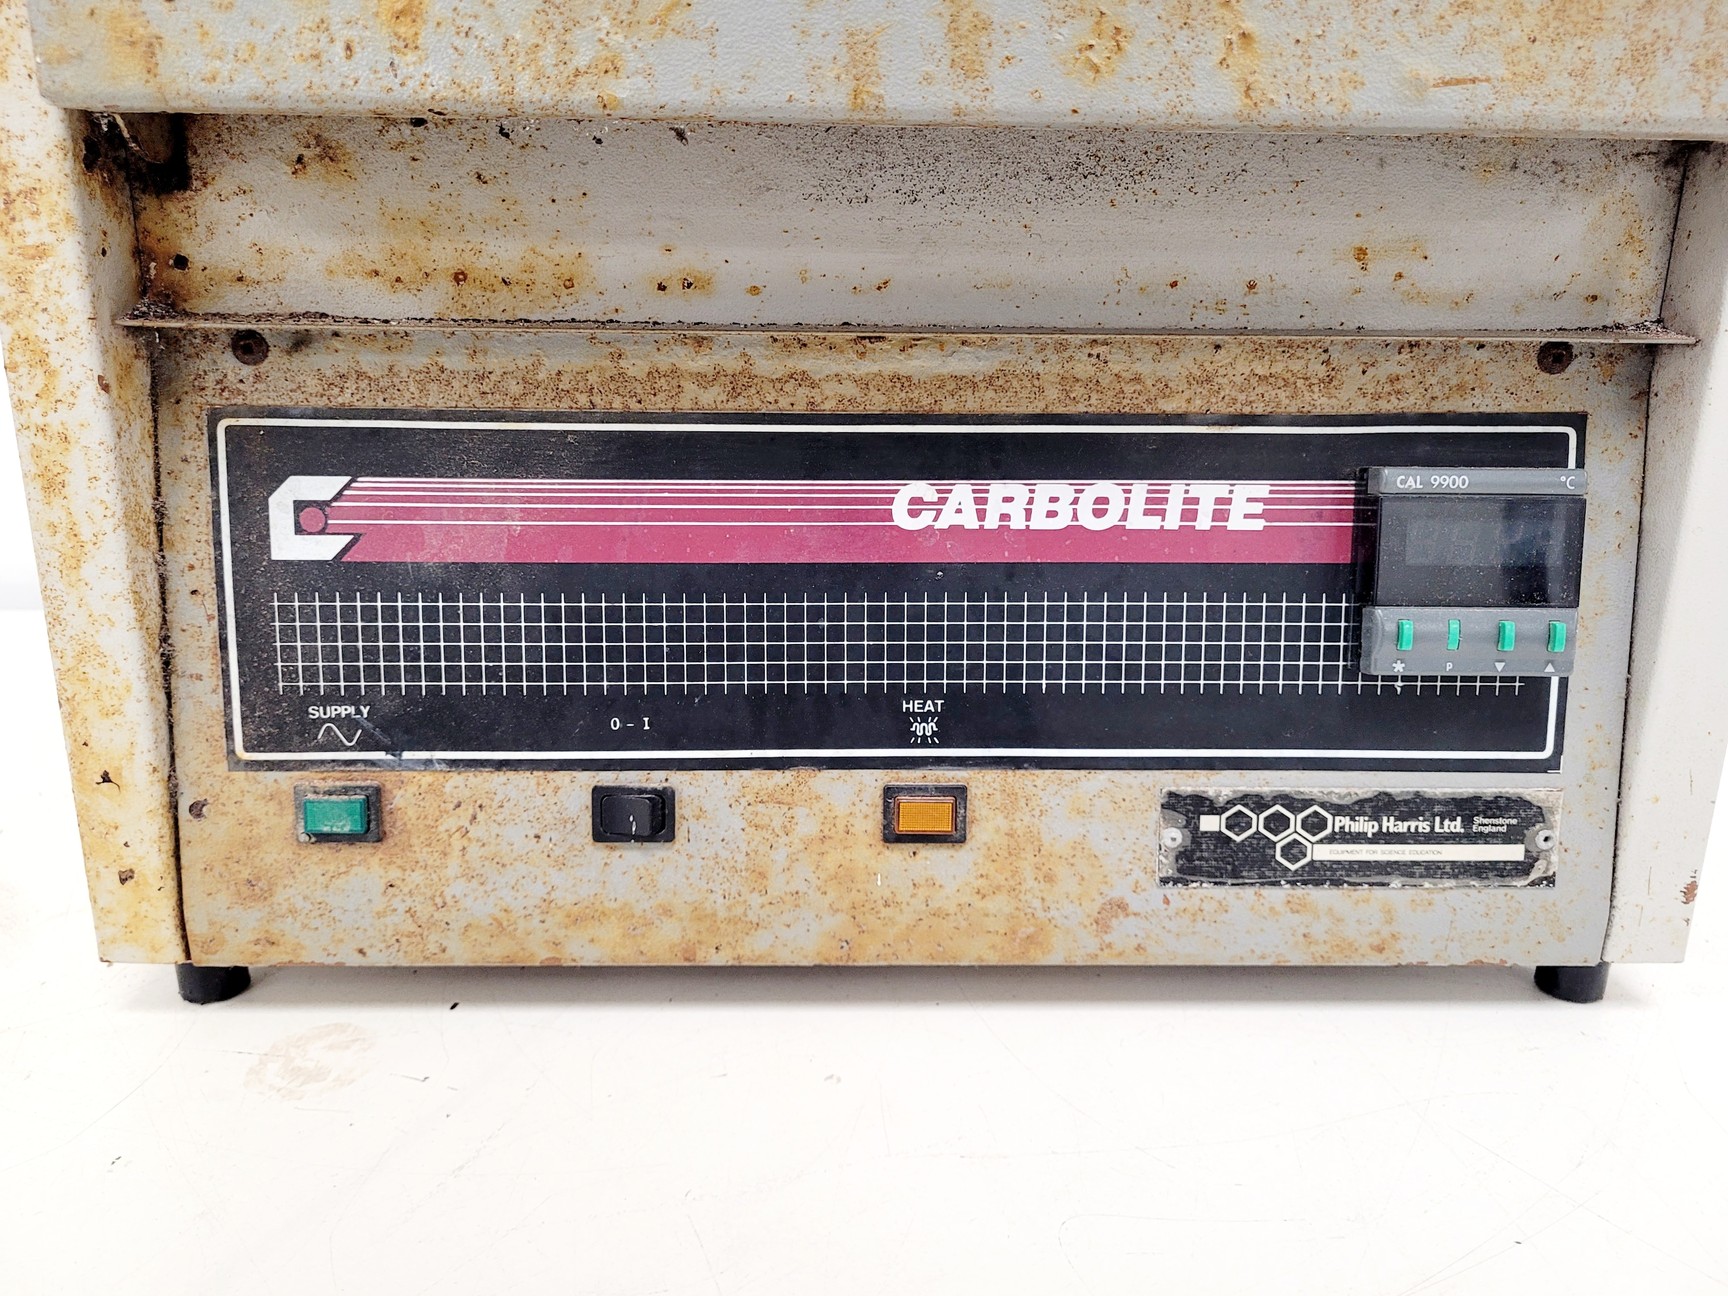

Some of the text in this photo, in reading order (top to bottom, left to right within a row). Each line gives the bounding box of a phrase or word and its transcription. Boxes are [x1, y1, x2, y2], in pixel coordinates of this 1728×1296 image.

[1396, 475, 1469, 489] CAL 9900
[892, 483, 1270, 531] CARBOLITE
[1446, 662, 1453, 672] P
[308, 705, 371, 719] SUPPLY
[902, 700, 945, 713] HEAT
[1334, 815, 1465, 838] Philip Harris Ltd.
[1472, 816, 1518, 825] Shenstone
[1472, 825, 1507, 833] England
